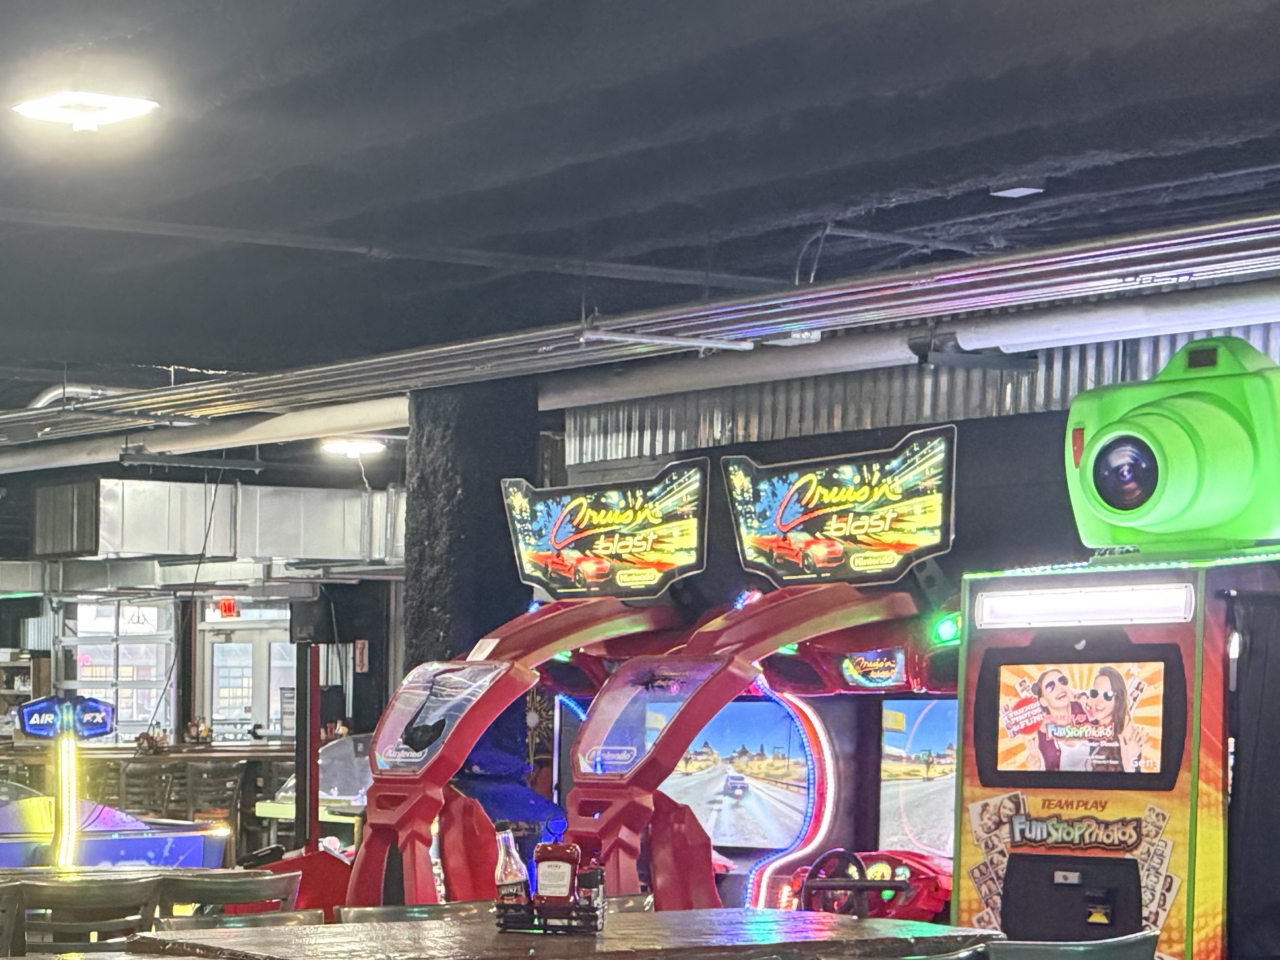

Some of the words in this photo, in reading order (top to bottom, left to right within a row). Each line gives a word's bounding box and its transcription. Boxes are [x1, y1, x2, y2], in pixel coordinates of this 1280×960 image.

[825, 509, 898, 537] blast
[593, 532, 658, 555] blast
[854, 554, 894, 566] Nintendo
[29, 713, 54, 725] AIR
[82, 711, 106, 724] FX
[590, 751, 632, 761] Nntendo
[1041, 798, 1076, 811] TEAM
[1075, 799, 1108, 812] PLAY
